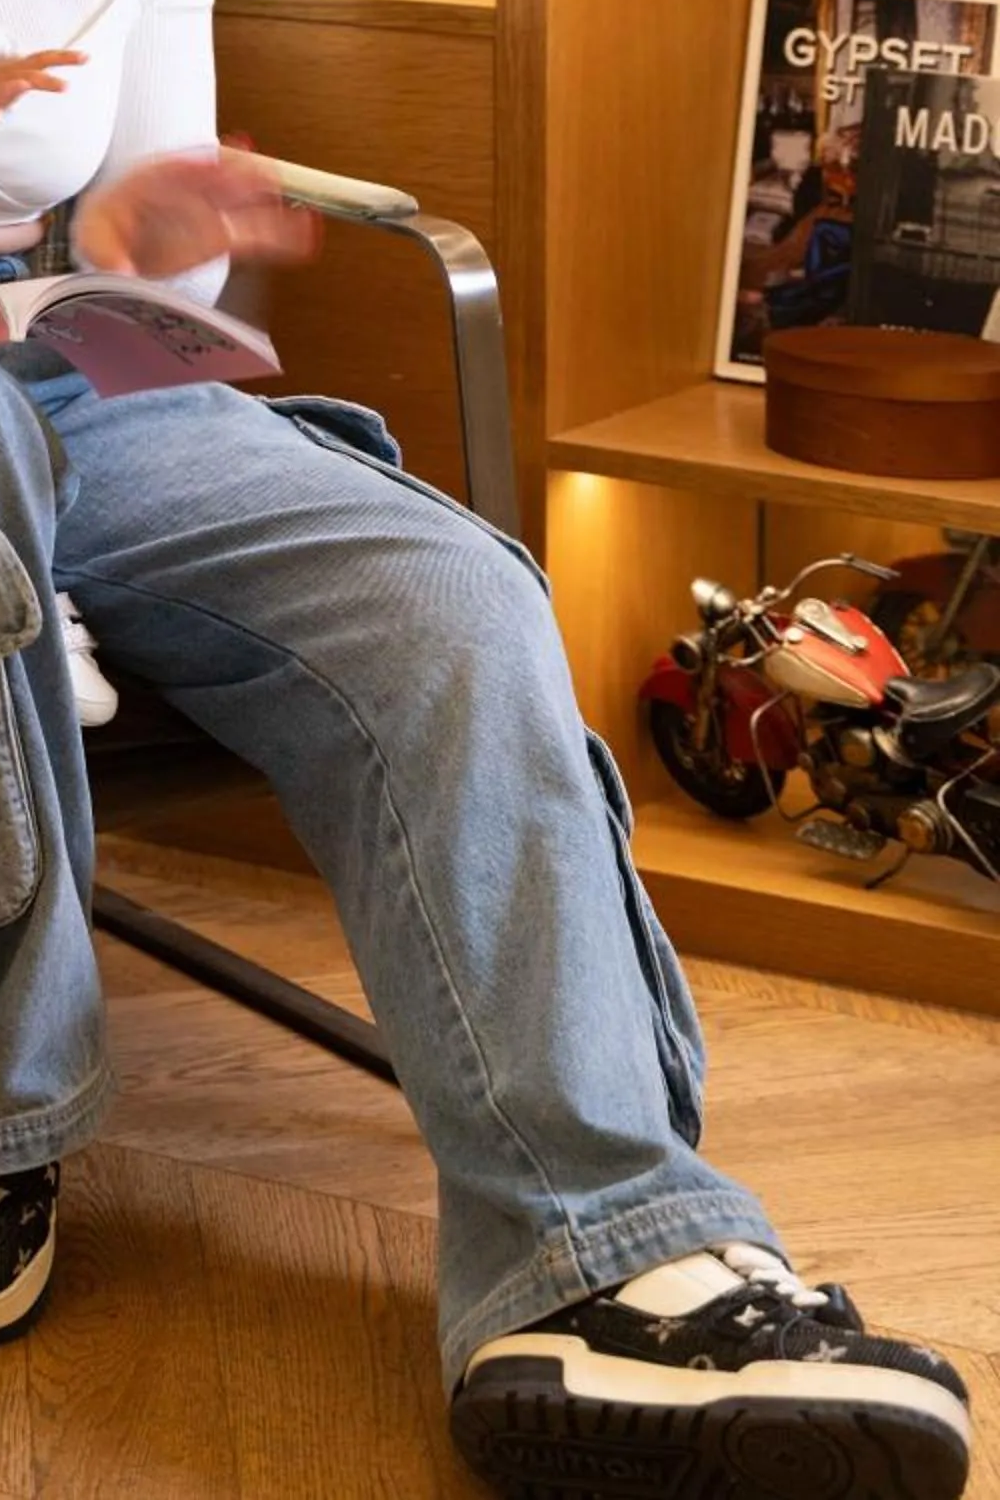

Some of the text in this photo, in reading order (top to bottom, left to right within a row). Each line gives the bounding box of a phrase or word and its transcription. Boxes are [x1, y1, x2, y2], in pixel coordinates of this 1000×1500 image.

[783, 26, 972, 74] GYPSET
[821, 73, 864, 104] ST
[895, 104, 1000, 161] MAD
